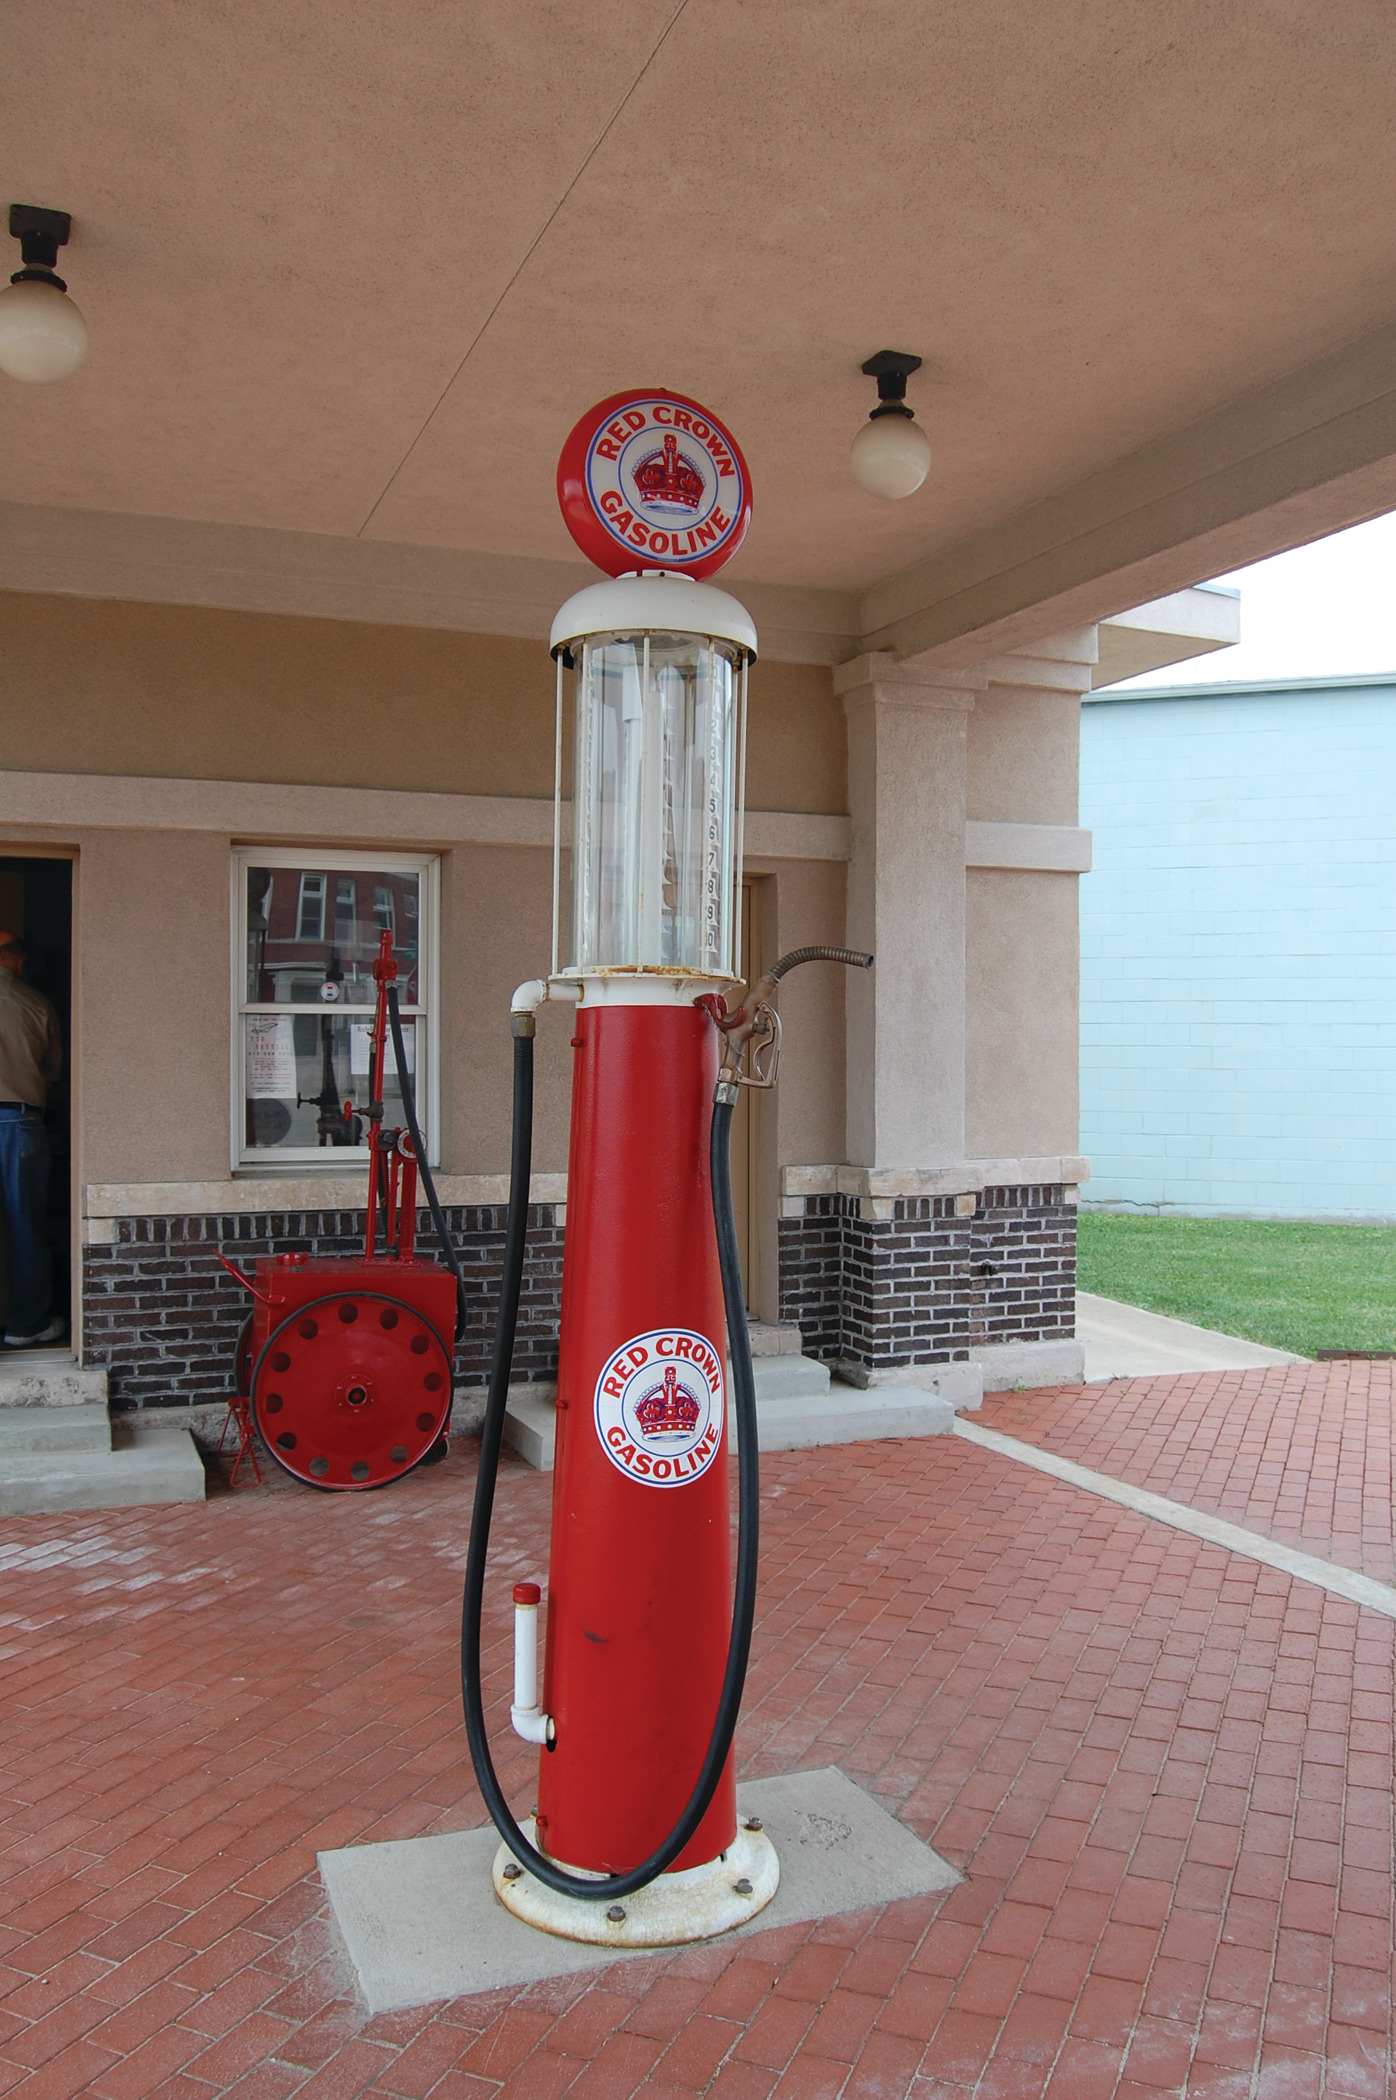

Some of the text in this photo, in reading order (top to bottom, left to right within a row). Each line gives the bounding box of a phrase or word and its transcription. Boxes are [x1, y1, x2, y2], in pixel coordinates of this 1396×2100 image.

[596, 406, 735, 477] RED CROWN
[600, 490, 730, 556] GASOLINE
[709, 798, 716, 813] 5
[709, 826, 715, 840] 6
[708, 852, 715, 866] 7
[708, 880, 714, 894] 8
[707, 905, 713, 920] 9
[603, 1337, 721, 1399] RED CROWN
[607, 1422, 718, 1479] GASOLINE
